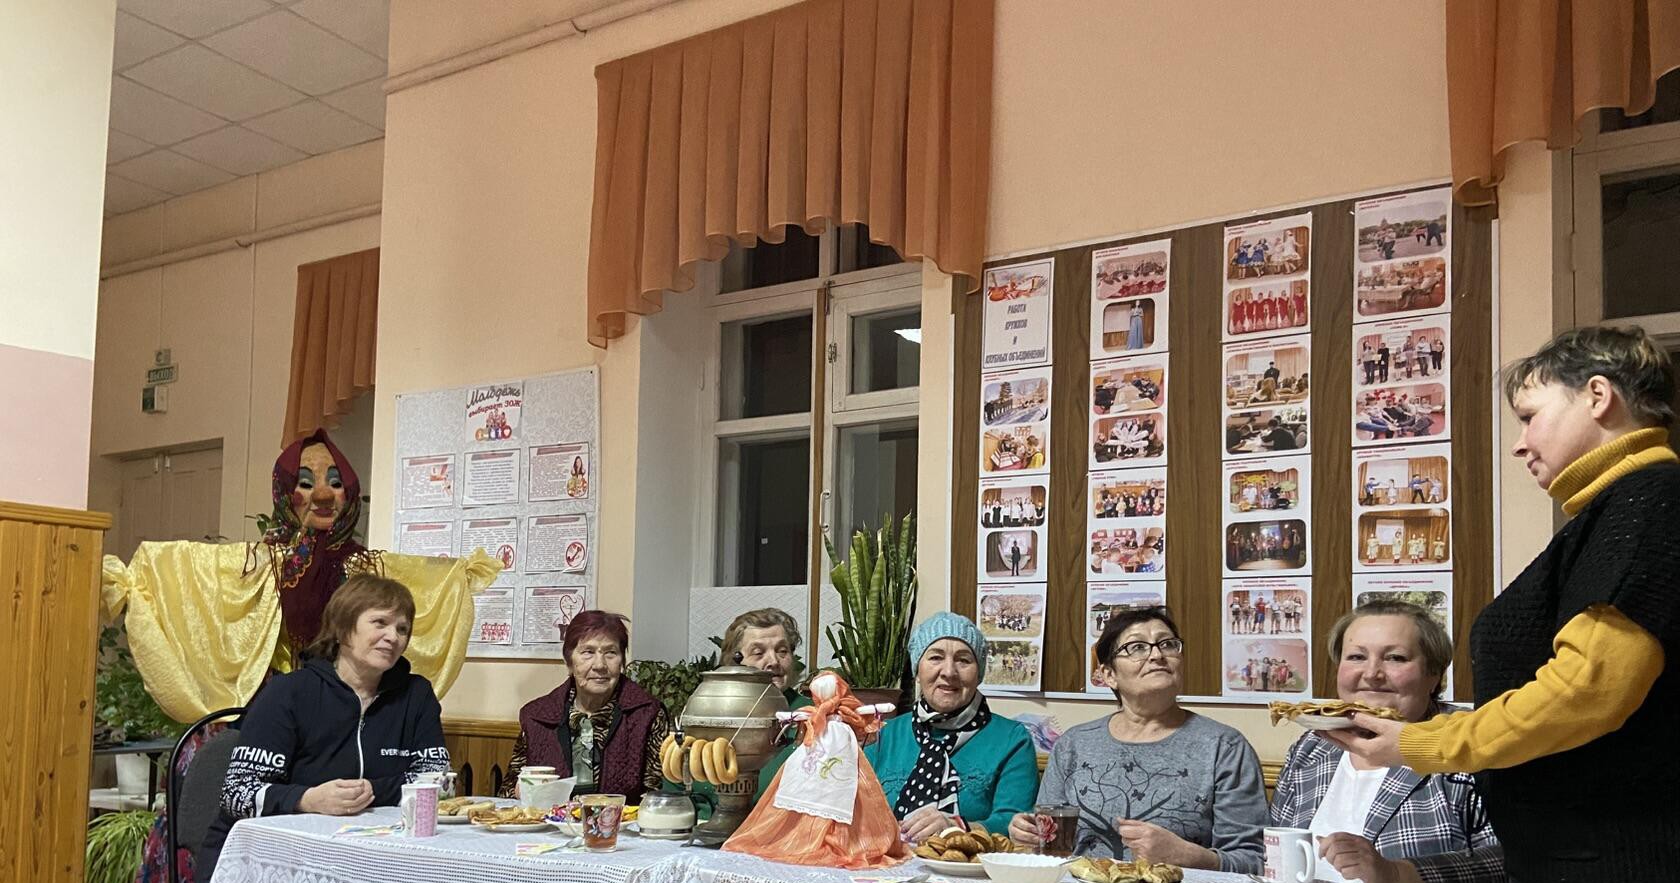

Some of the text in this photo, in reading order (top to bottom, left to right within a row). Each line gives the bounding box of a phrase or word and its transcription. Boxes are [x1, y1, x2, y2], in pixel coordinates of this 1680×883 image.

[1007, 304, 1027, 314] РАБОТА
[231, 746, 286, 768] YTHING
[254, 764, 275, 772] COPY
